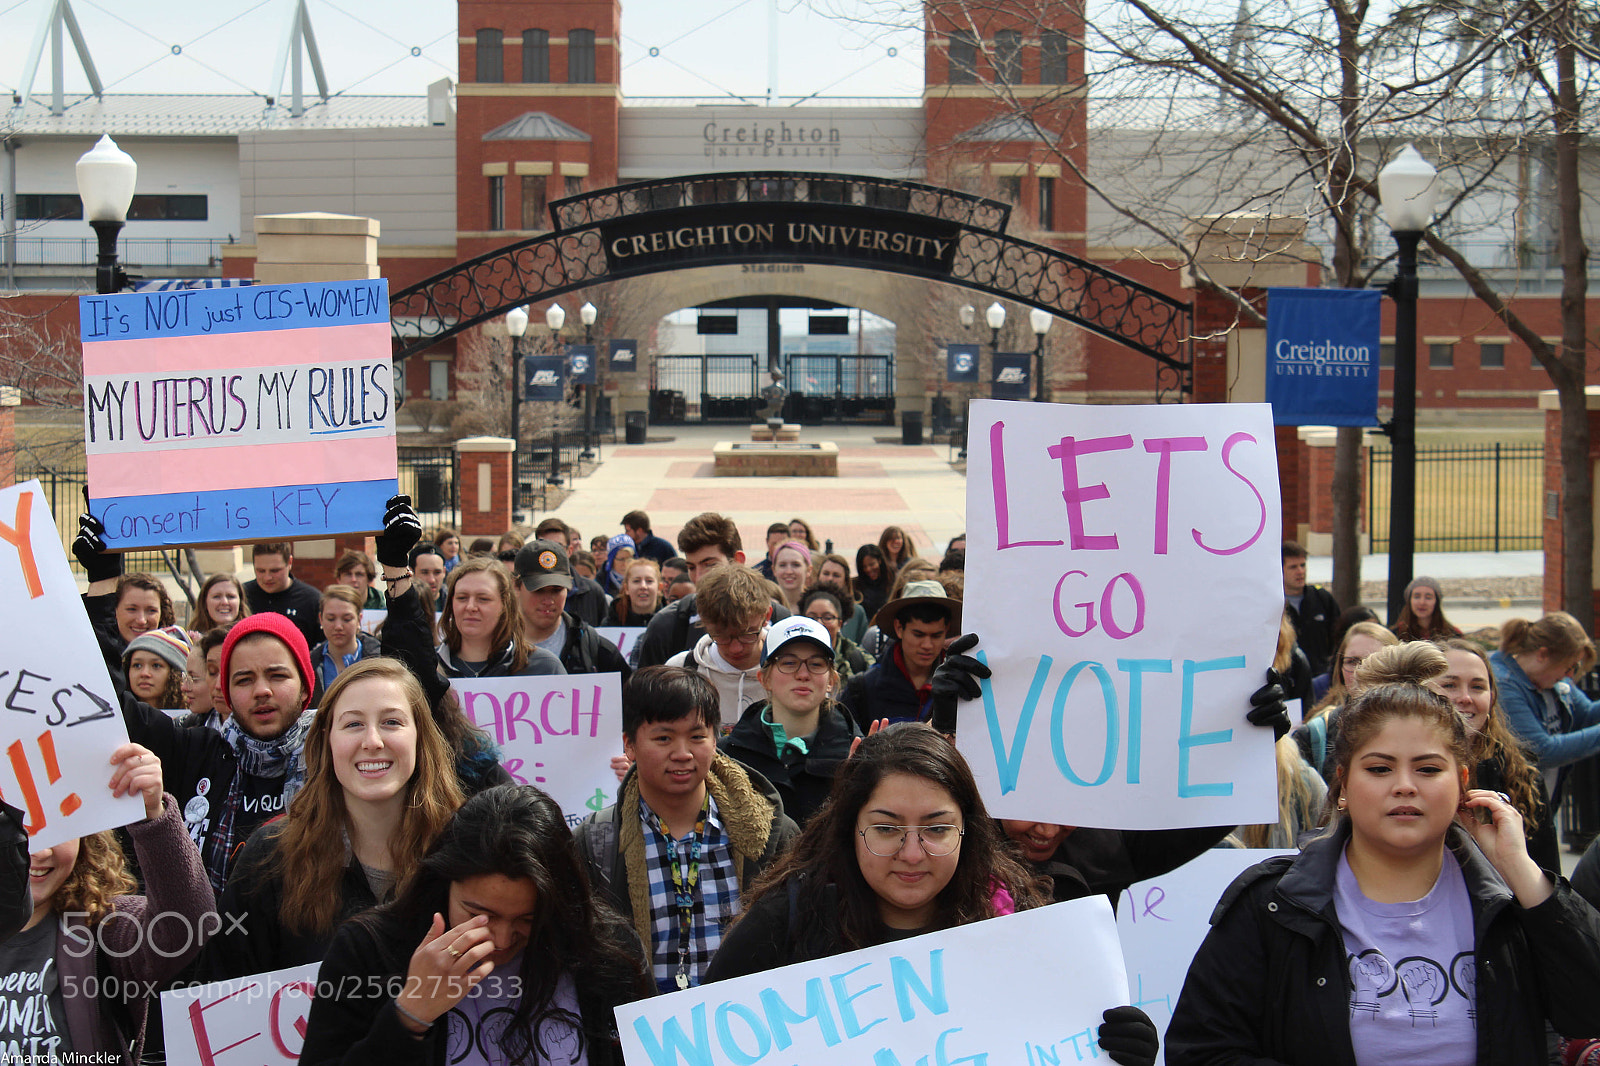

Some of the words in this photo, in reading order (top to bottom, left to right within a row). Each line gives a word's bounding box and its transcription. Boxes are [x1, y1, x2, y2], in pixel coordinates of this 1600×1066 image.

[703, 121, 841, 148] Creighton
[703, 147, 841, 158] UNIVERSITY
[610, 223, 776, 259] CREIGHTON
[787, 222, 952, 261] UNIVERSITY
[741, 264, 805, 273] Stadium
[87, 299, 130, 337] It's
[145, 292, 196, 331] NOT
[201, 292, 244, 332] just
[253, 285, 381, 321] CIS-WOMEN
[1275, 338, 1370, 367] Creighton
[1275, 365, 1370, 378] UNIVERSITY
[88, 380, 130, 443] MY
[134, 375, 247, 441] UTERUS
[256, 369, 298, 430] MY
[308, 363, 389, 431] RULES
[100, 495, 206, 541] Consent
[224, 501, 251, 530] is
[272, 487, 342, 529] KEY
[989, 420, 1267, 556] LETS
[1052, 570, 1146, 641] GO
[452, 684, 604, 746] ARCH
[976, 649, 1246, 799] VOTE
[633, 948, 950, 1066] WOMEN
